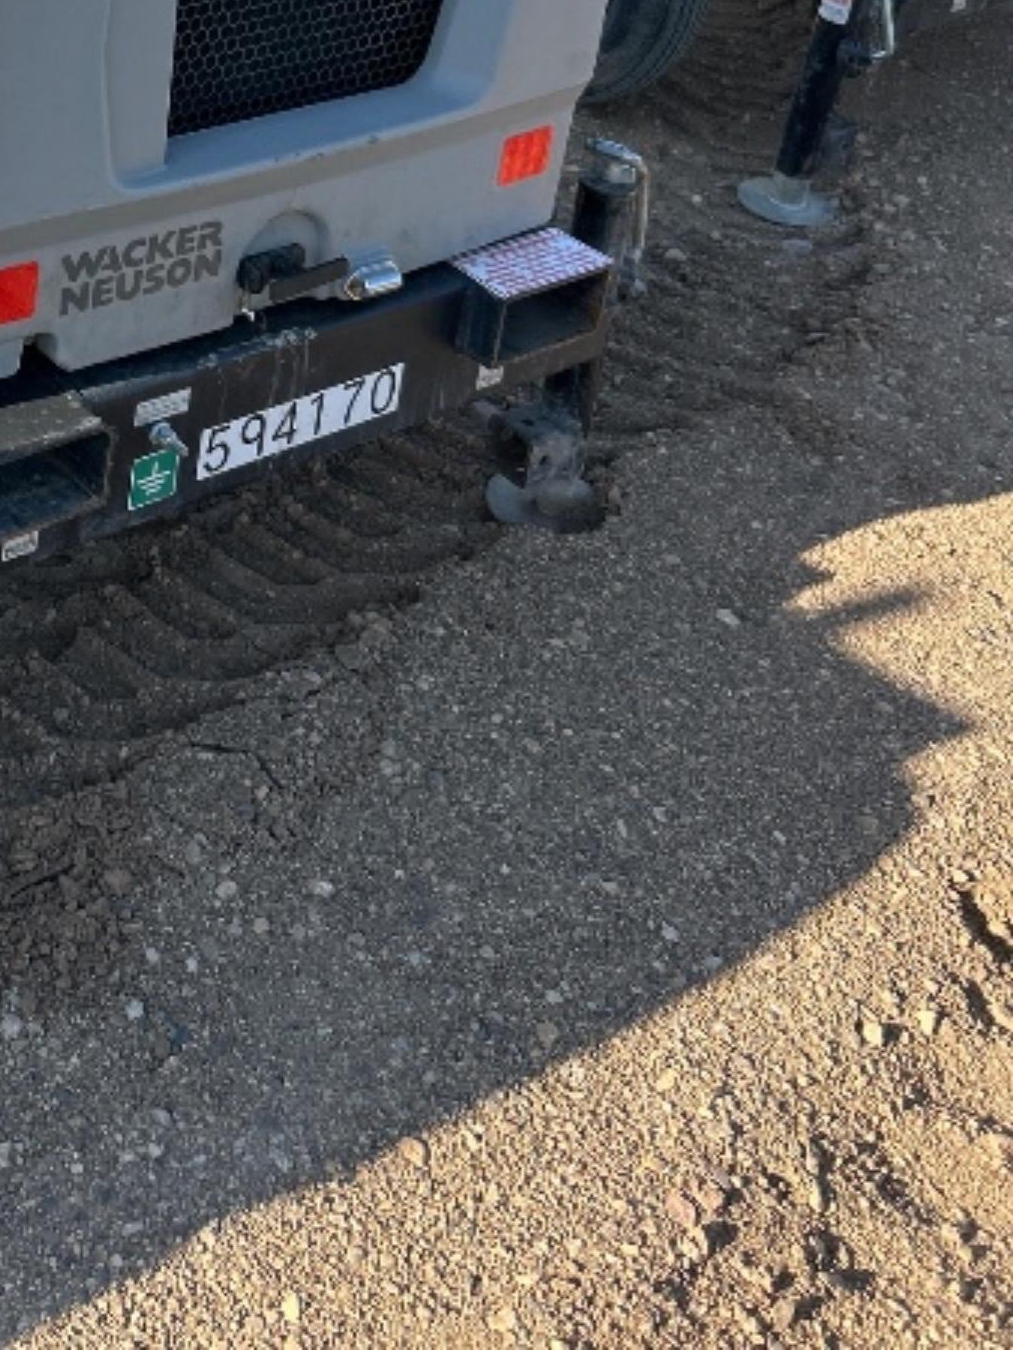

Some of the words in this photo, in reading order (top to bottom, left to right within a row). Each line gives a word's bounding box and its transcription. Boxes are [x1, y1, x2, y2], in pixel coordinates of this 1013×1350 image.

[60, 250, 221, 315] NEUSON
[61, 222, 222, 282] WACKER
[203, 369, 396, 472] 594170
